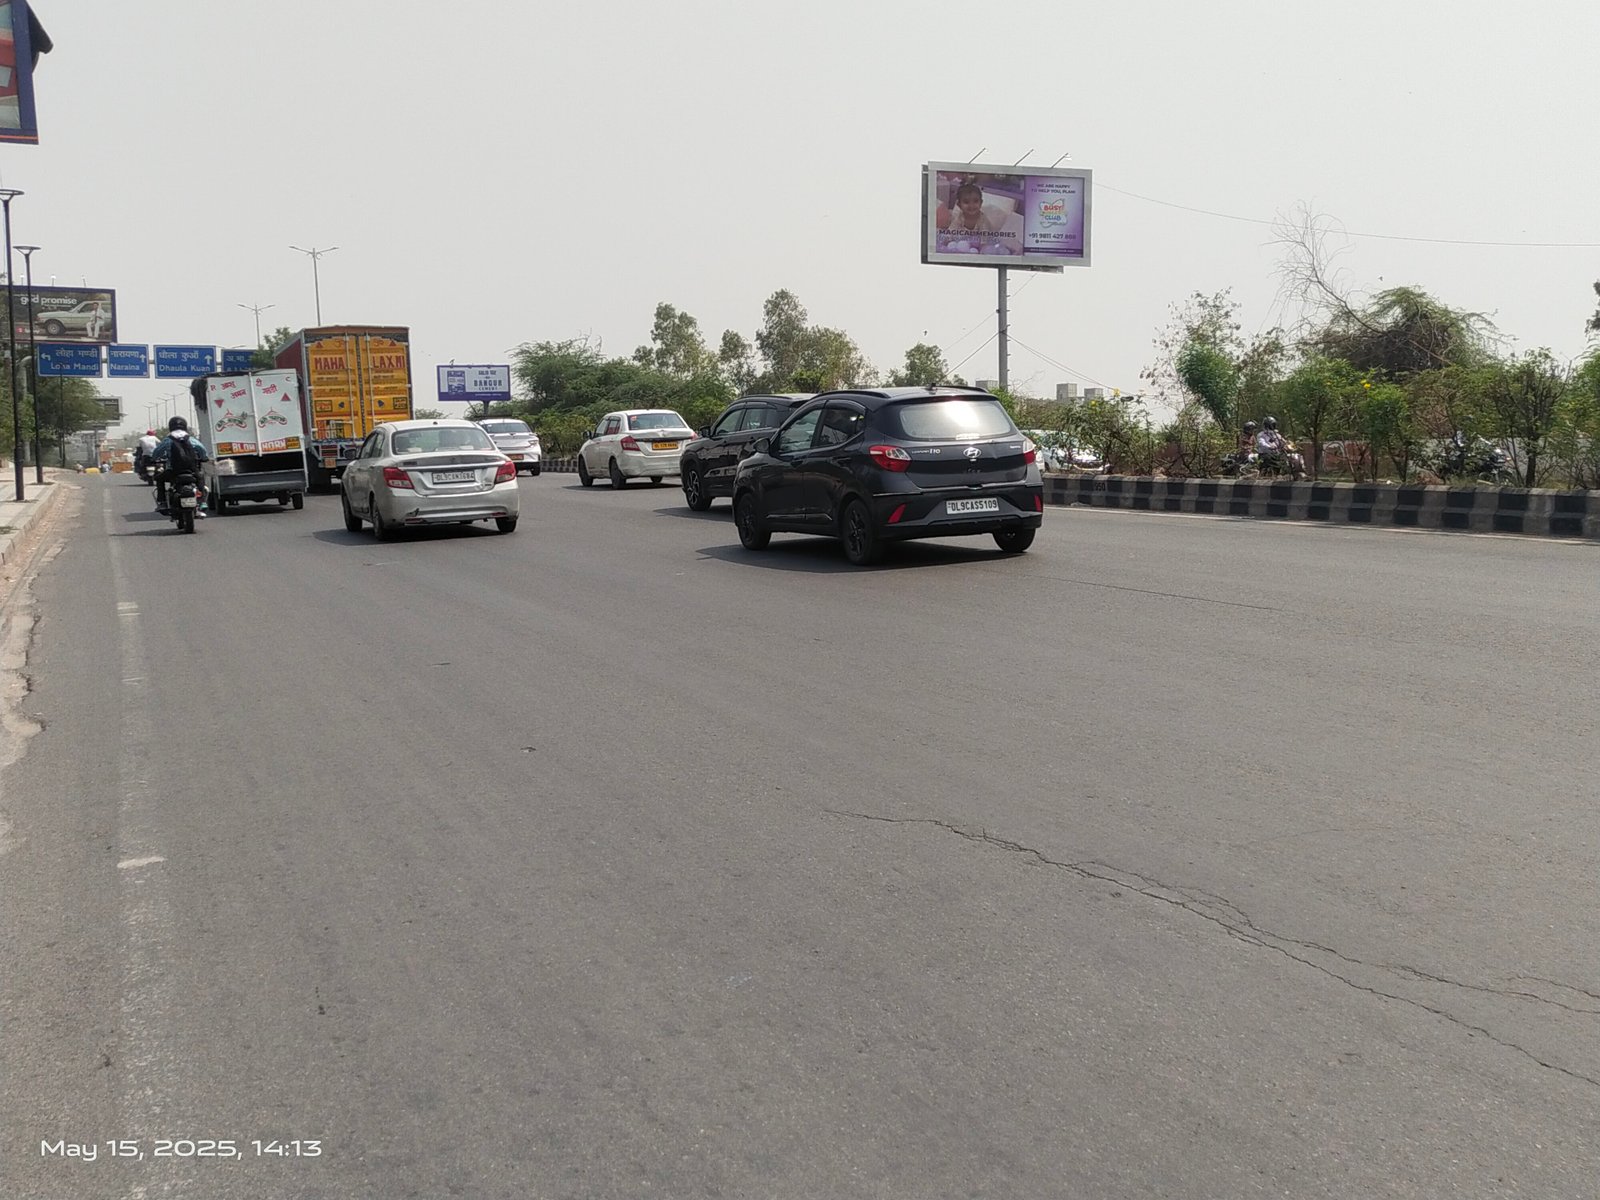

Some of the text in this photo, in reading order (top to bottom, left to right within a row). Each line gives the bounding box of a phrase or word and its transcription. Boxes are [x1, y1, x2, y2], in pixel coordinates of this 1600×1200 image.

[41, 296, 78, 306] promise
[74, 362, 99, 371] Mandi
[110, 363, 140, 371] Naraina
[315, 355, 405, 370] MAHA LAXMI
[159, 364, 211, 372] Dhaula Kuan
[473, 379, 503, 387] BANGUR
[261, 440, 286, 452] HORN
[951, 499, 998, 512] DL9CAS5109
